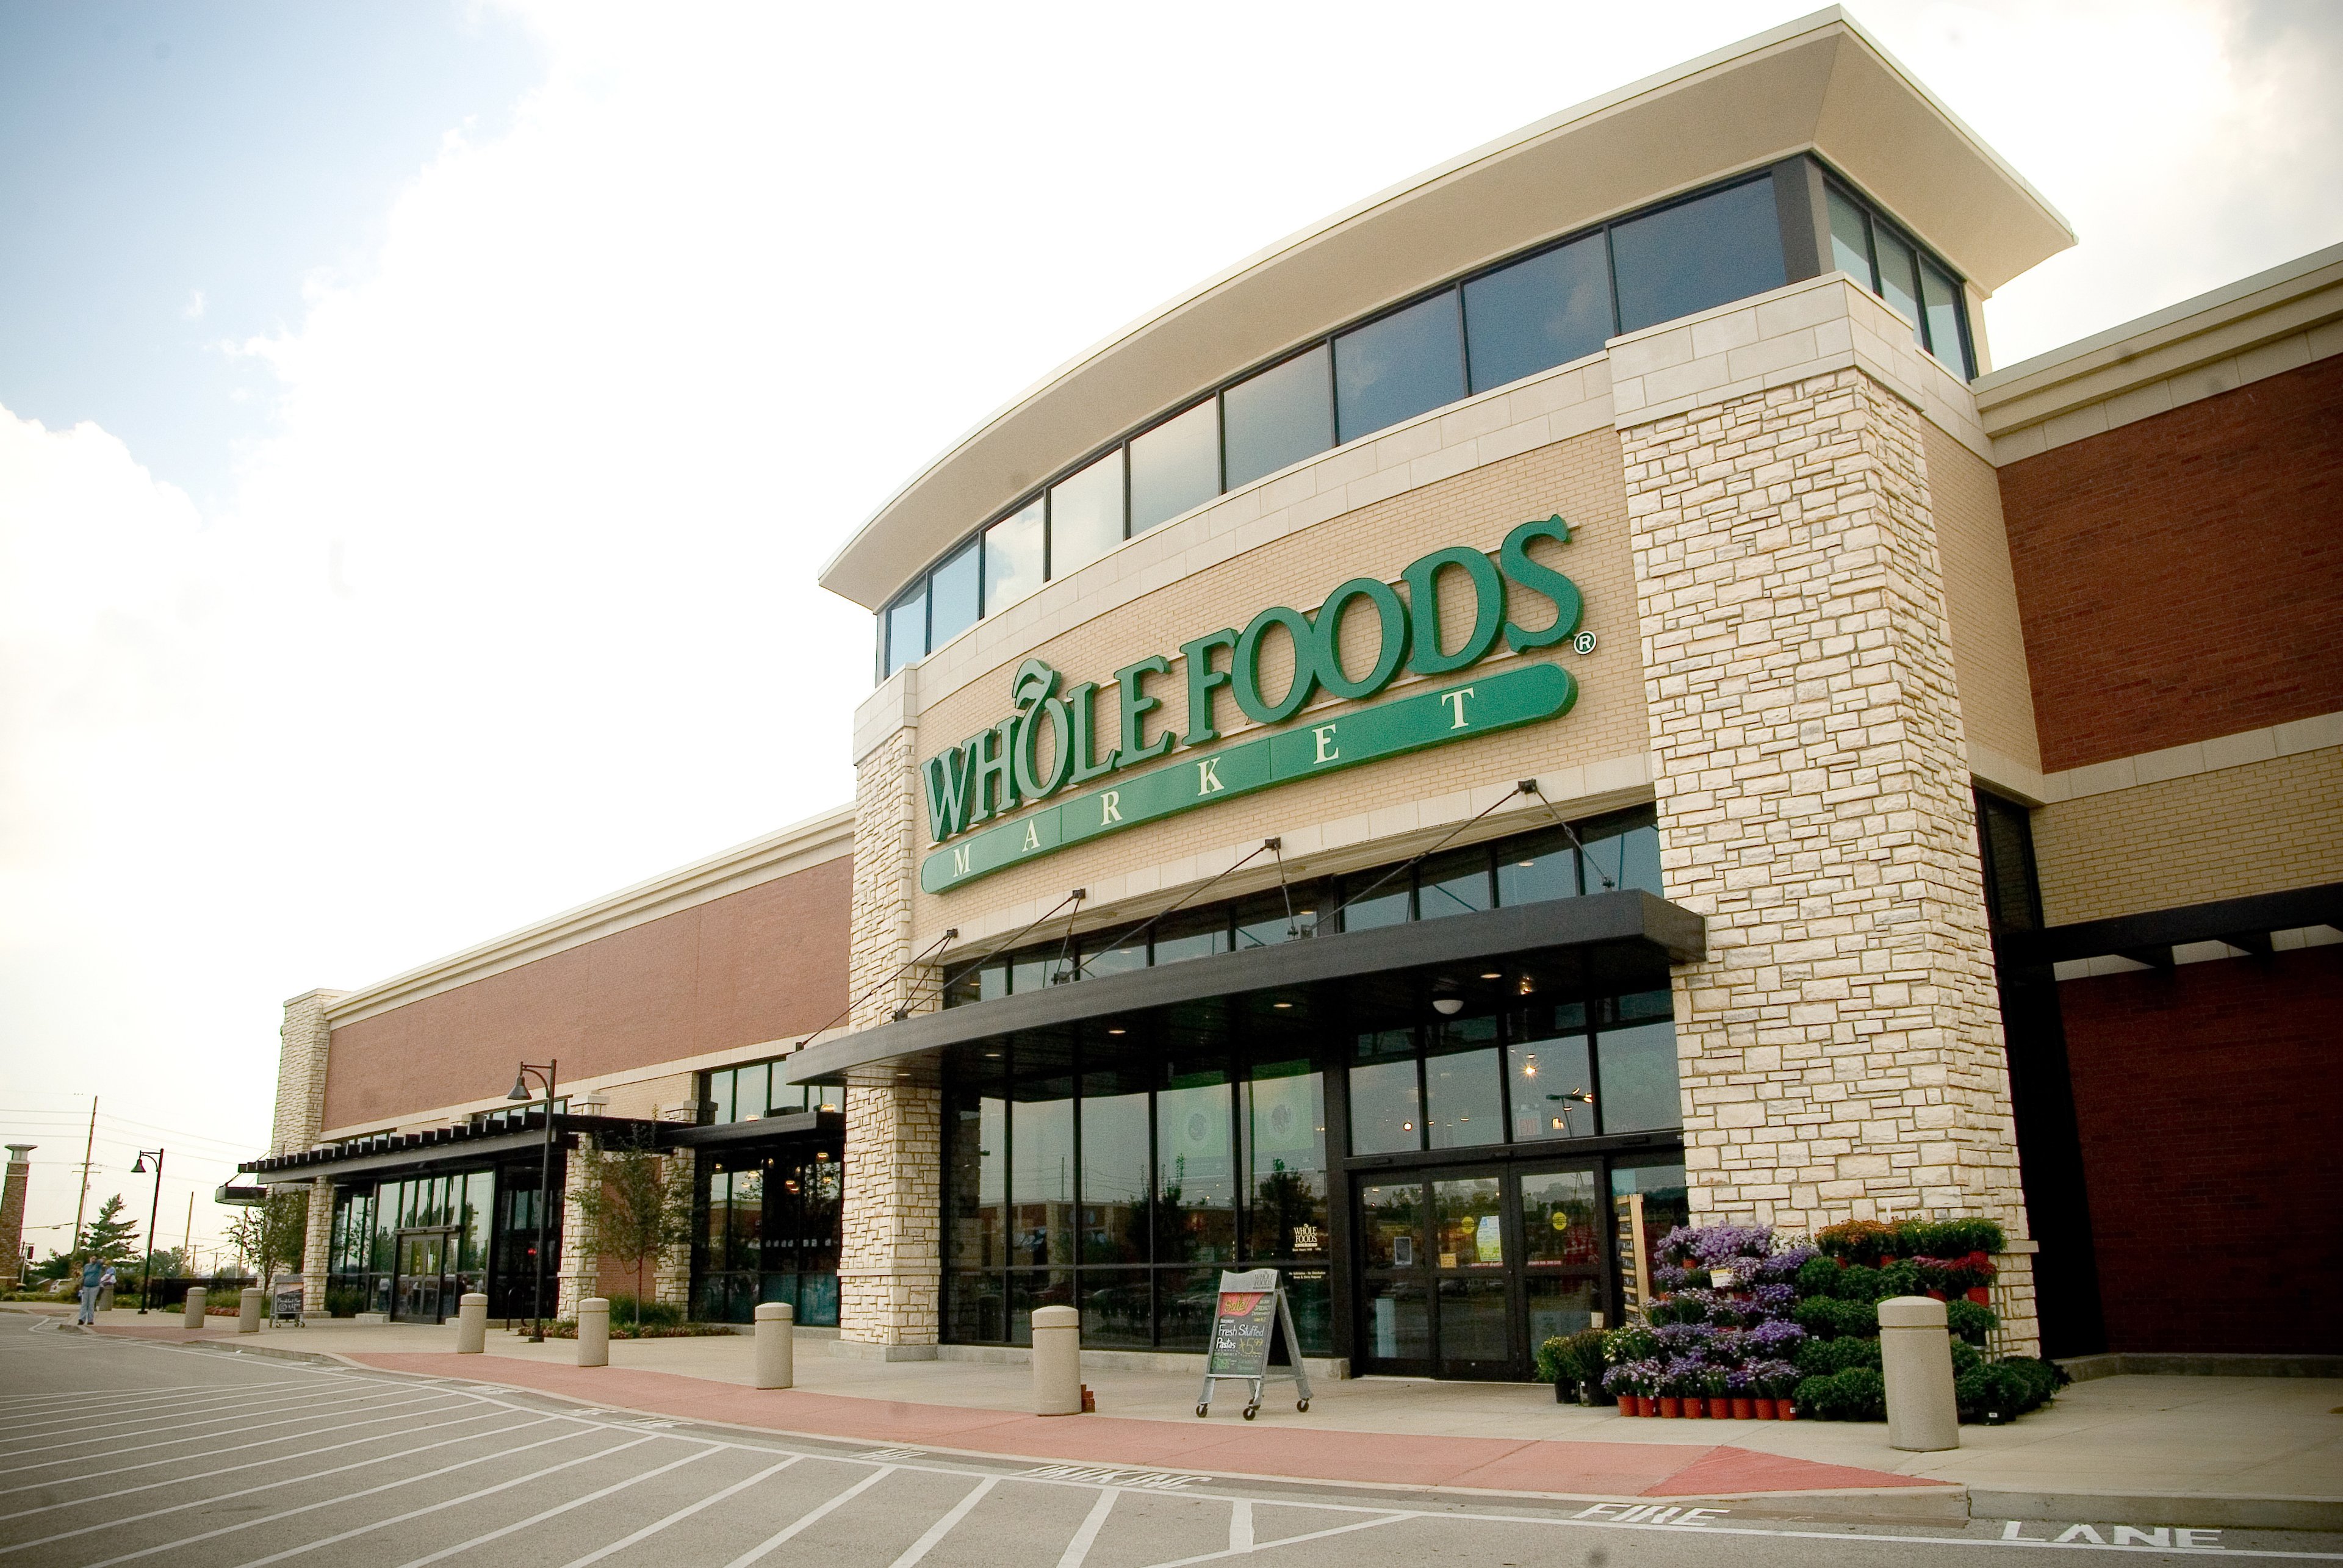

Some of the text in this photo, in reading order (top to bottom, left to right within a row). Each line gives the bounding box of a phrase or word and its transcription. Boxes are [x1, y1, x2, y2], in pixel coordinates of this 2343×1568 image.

[920, 658, 1176, 843] WHOLE
[1179, 514, 1583, 746] FOODS
[952, 688, 1475, 877] MARKET
[1294, 1223, 1317, 1235] WHOLE
[1295, 1234, 1317, 1243] FOODS
[1218, 1324, 1265, 1337] Fresh Stuffed
[1215, 1337, 1236, 1349] Pastas
[1009, 1465, 1213, 1490] PARKING
[1571, 1502, 2225, 1550] FIRE LANE
